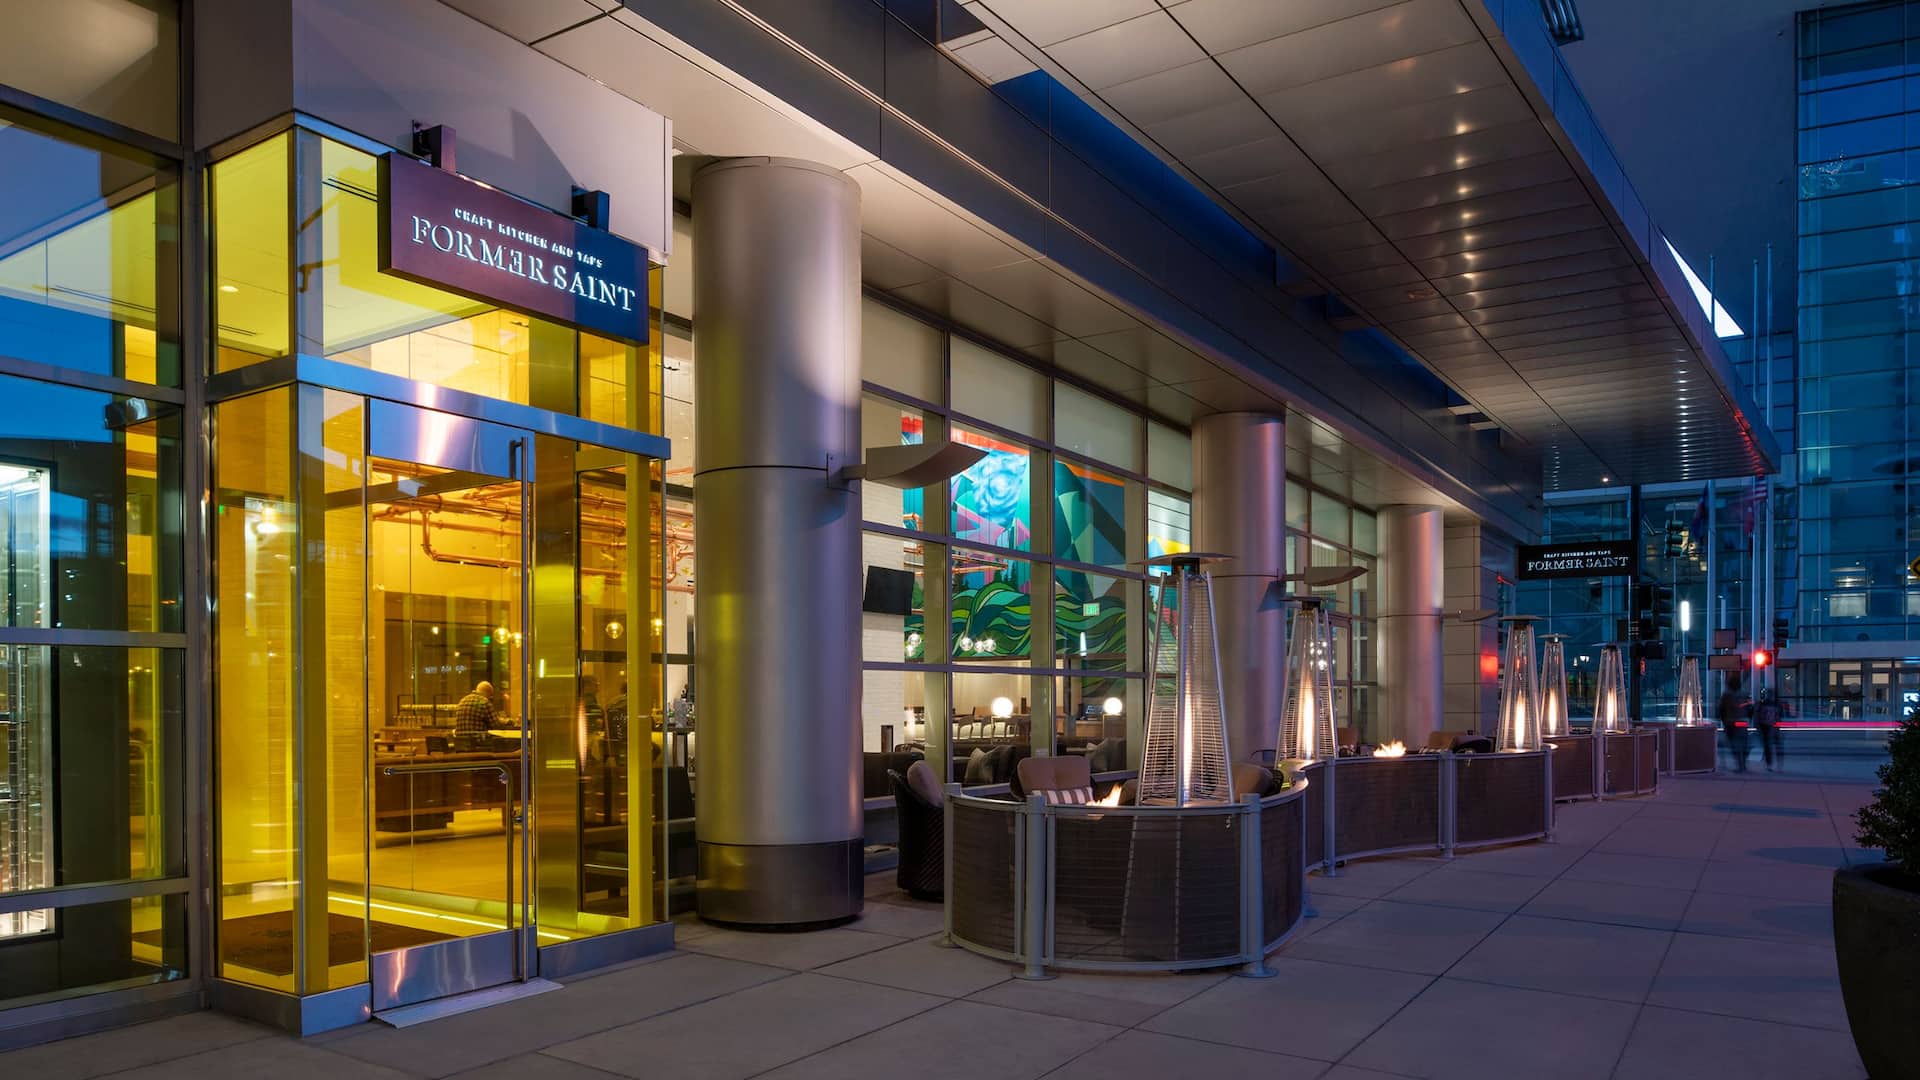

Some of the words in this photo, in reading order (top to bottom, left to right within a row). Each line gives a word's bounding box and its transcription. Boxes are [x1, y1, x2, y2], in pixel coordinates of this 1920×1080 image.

[411, 215, 549, 285] FORMER
[553, 264, 636, 312] SAINT
[454, 207, 494, 230] CRAFT
[498, 223, 548, 249] KITCHEN
[551, 242, 574, 258] AND
[576, 251, 603, 269] TAPS
[1527, 559, 1585, 571] FORMER
[1586, 556, 1629, 568] SAINT
